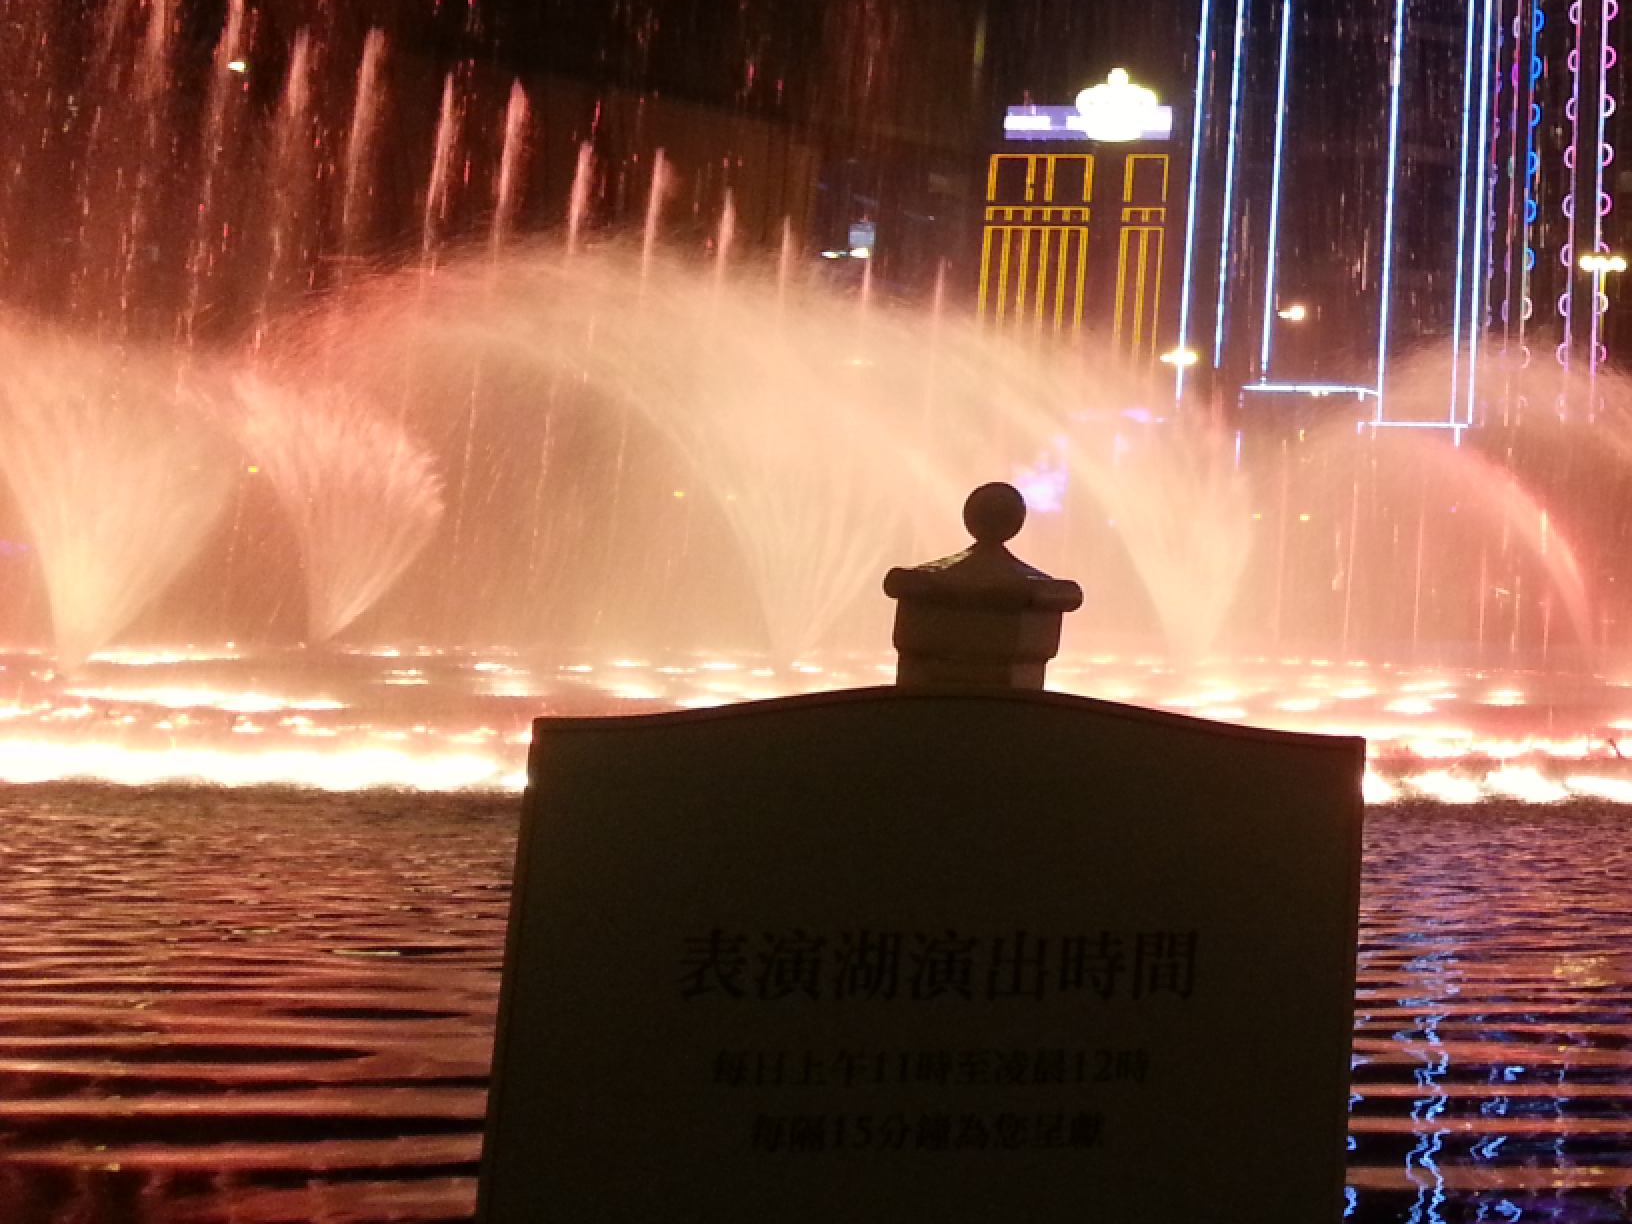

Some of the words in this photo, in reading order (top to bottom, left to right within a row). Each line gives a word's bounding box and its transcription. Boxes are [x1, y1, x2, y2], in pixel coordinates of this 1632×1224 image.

[680, 927, 1201, 1002] 表演湖演出時間
